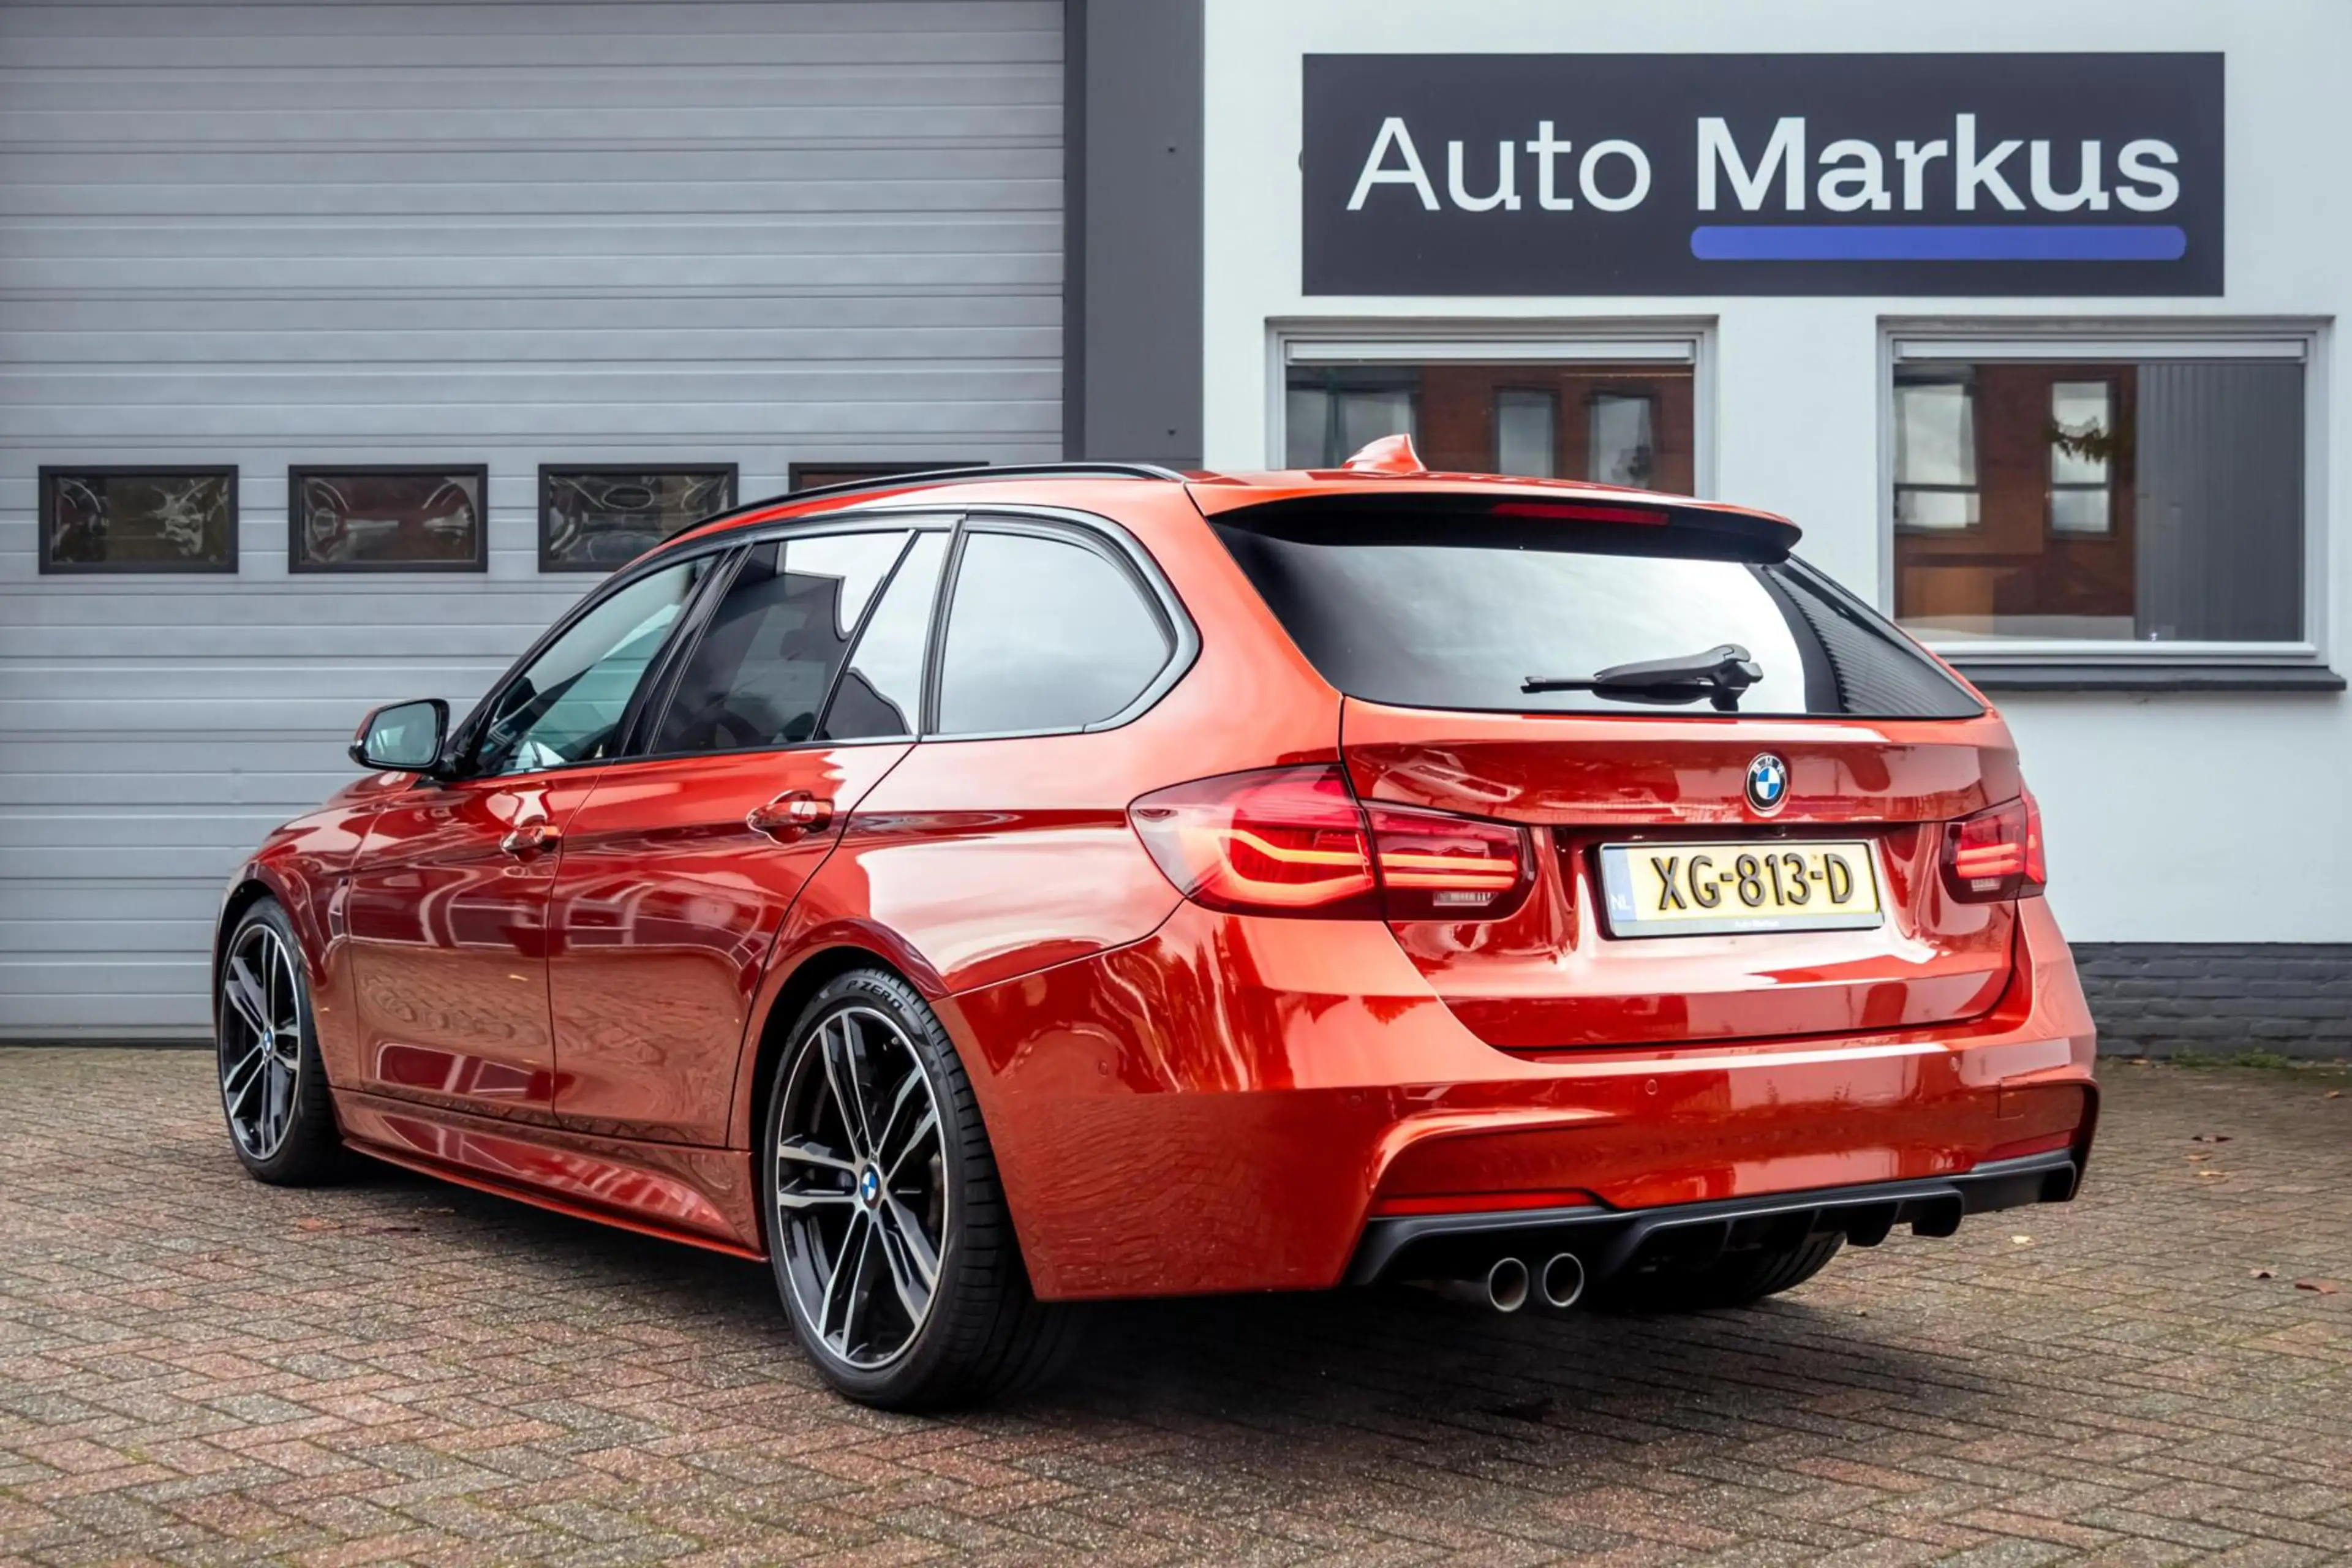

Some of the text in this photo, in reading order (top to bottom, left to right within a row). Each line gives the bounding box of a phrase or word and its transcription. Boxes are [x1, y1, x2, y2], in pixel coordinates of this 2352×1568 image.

[1347, 113, 2180, 211] Auto Markus
[1610, 894, 1630, 910] NL
[1651, 853, 1855, 910] XG-813-D
[859, 981, 903, 1011] ZERO
